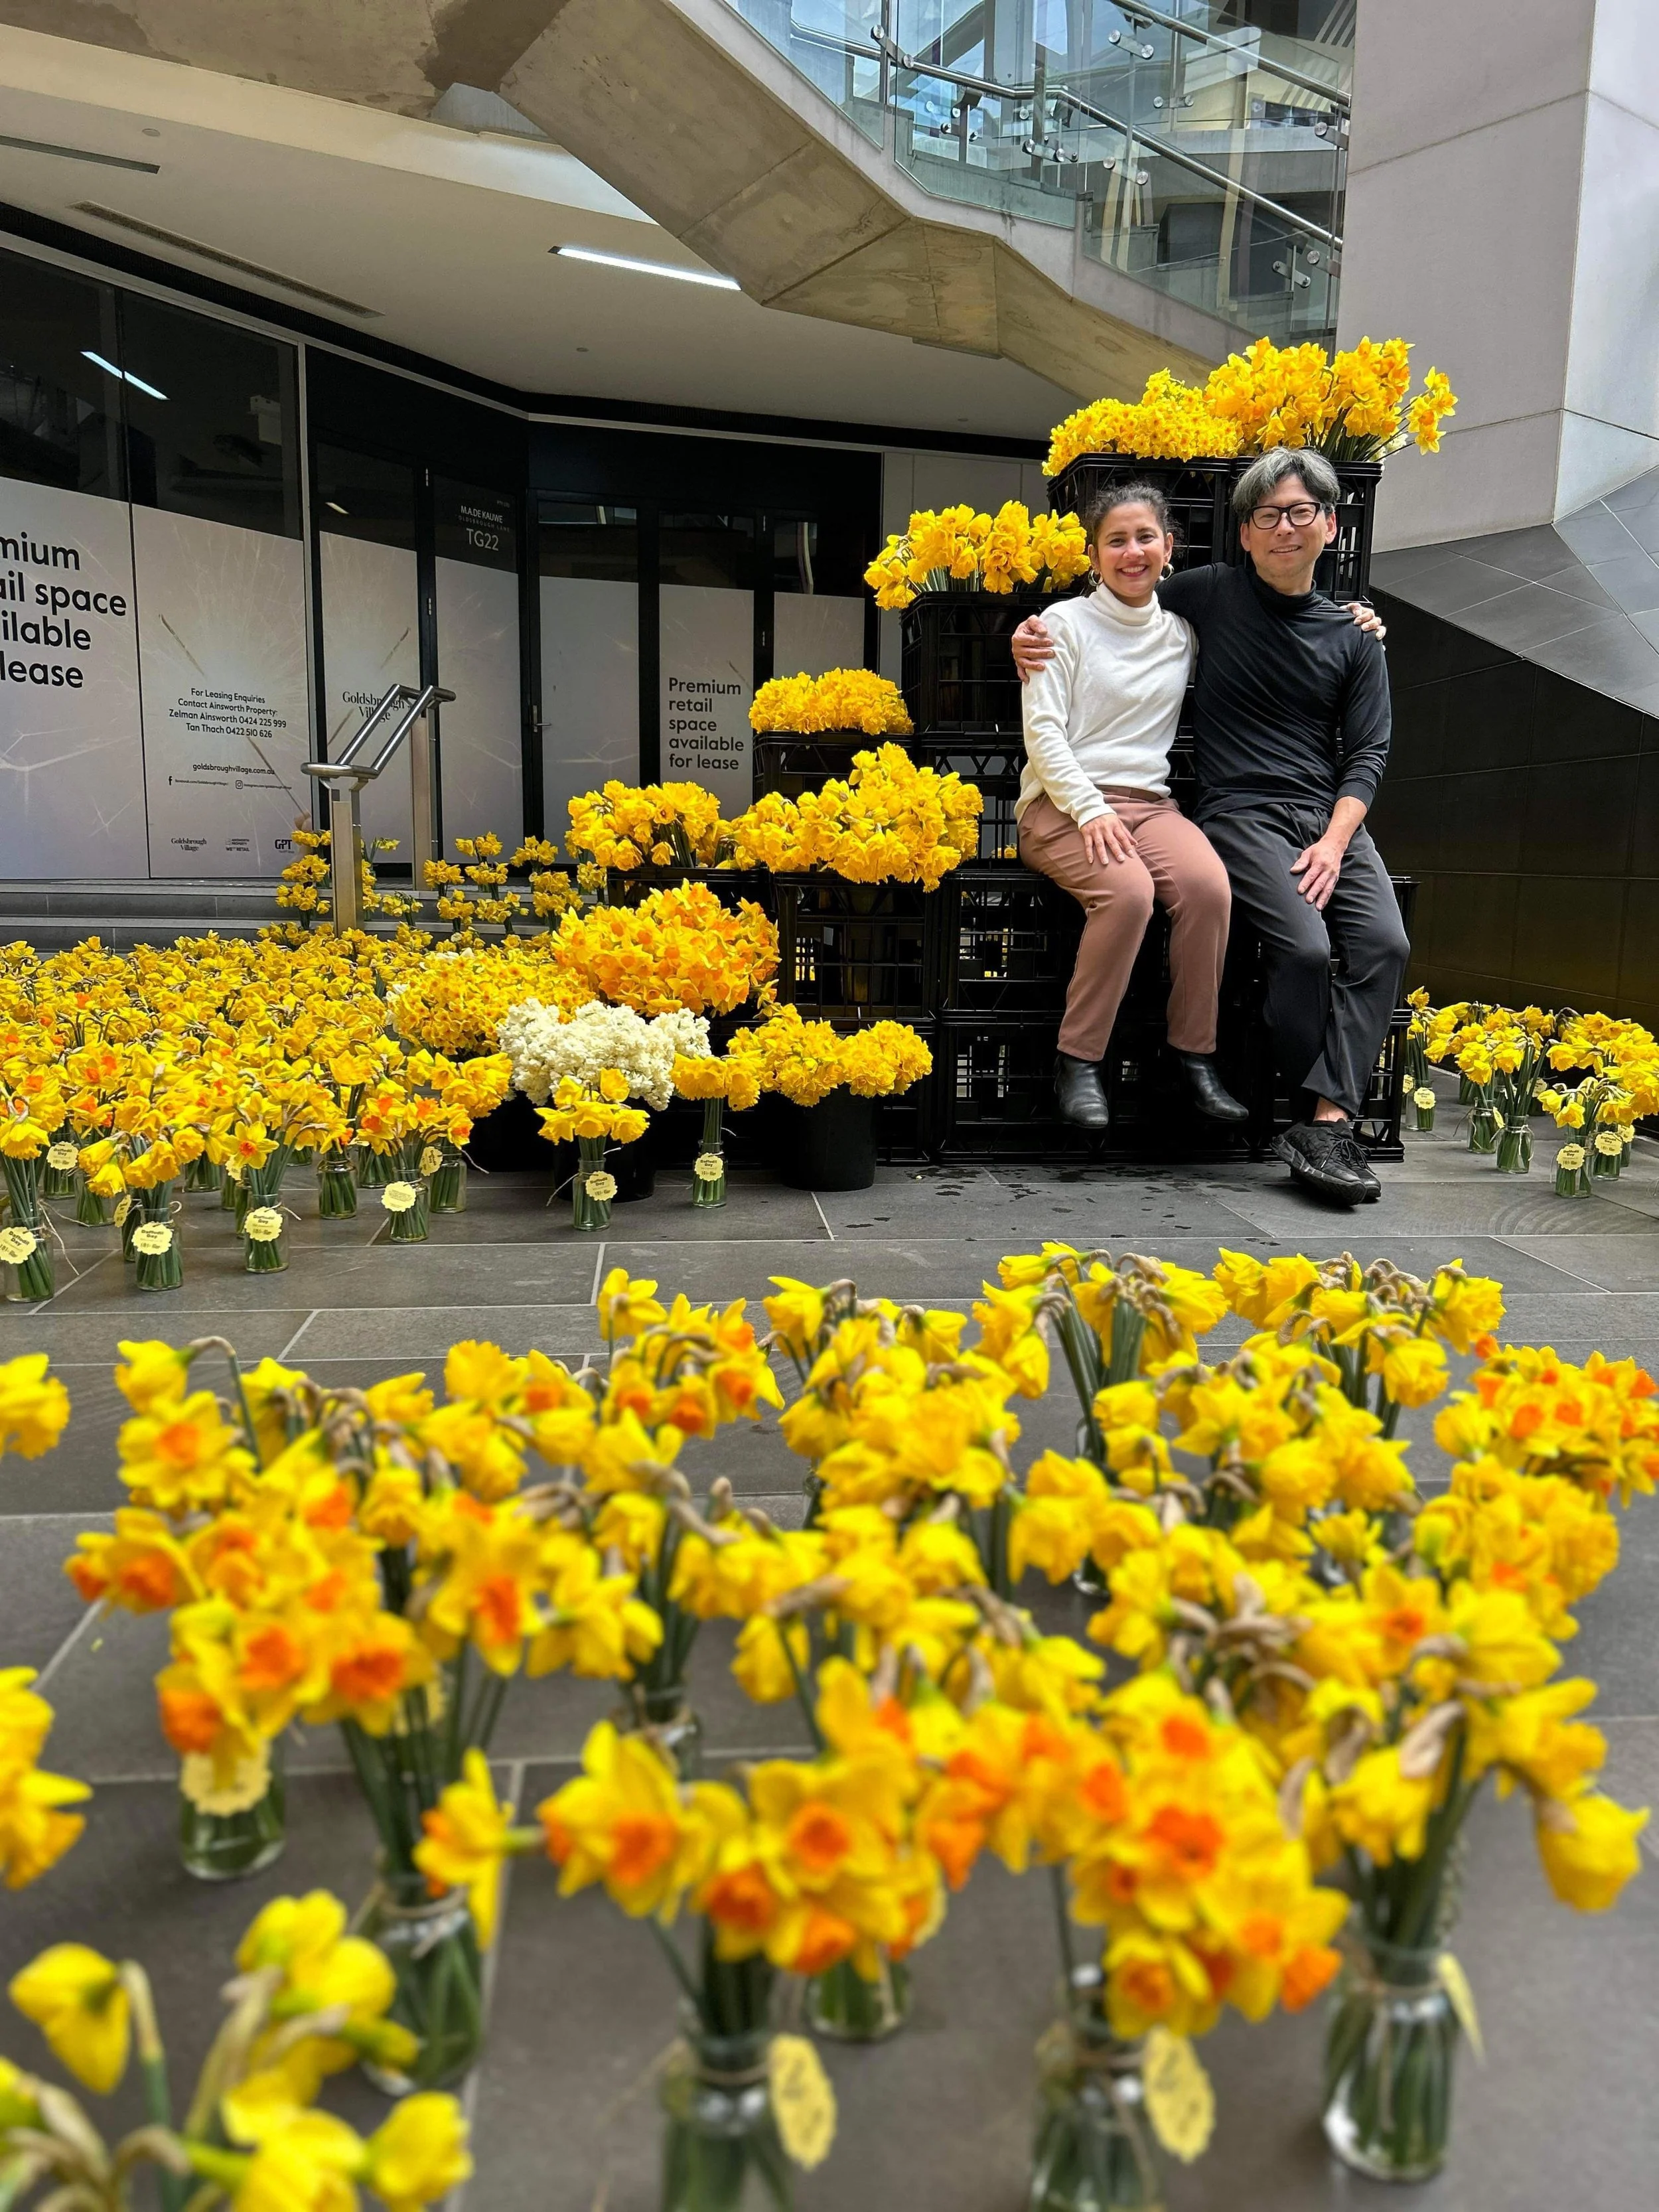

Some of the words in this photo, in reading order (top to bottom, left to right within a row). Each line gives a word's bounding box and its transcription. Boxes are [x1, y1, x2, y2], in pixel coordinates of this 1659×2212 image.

[482, 511, 503, 524] KAUWE
[466, 528, 498, 551] TG22
[35, 583, 127, 616] space
[0, 650, 84, 688] lease
[669, 677, 741, 695] Premium
[191, 688, 204, 697] For
[205, 690, 232, 701] Leasing
[234, 693, 265, 703] Enquiries
[178, 698, 207, 709] Contact
[209, 702, 244, 712] Ainsworth
[669, 698, 712, 712] retail
[169, 709, 198, 720] Zelman
[200, 713, 238, 723] Ainsworth
[239, 717, 257, 725] 0424
[259, 718, 271, 727] 225
[186, 723, 200, 732] Tan
[201, 724, 224, 734] Thach
[226, 727, 245, 736] 0422
[669, 719, 717, 734] space
[669, 735, 744, 751] available
[192, 763, 275, 774] goldsbroughvillage.com.au
[669, 753, 692, 768] for
[697, 754, 739, 770] lease
[275, 839, 293, 849] GPT
